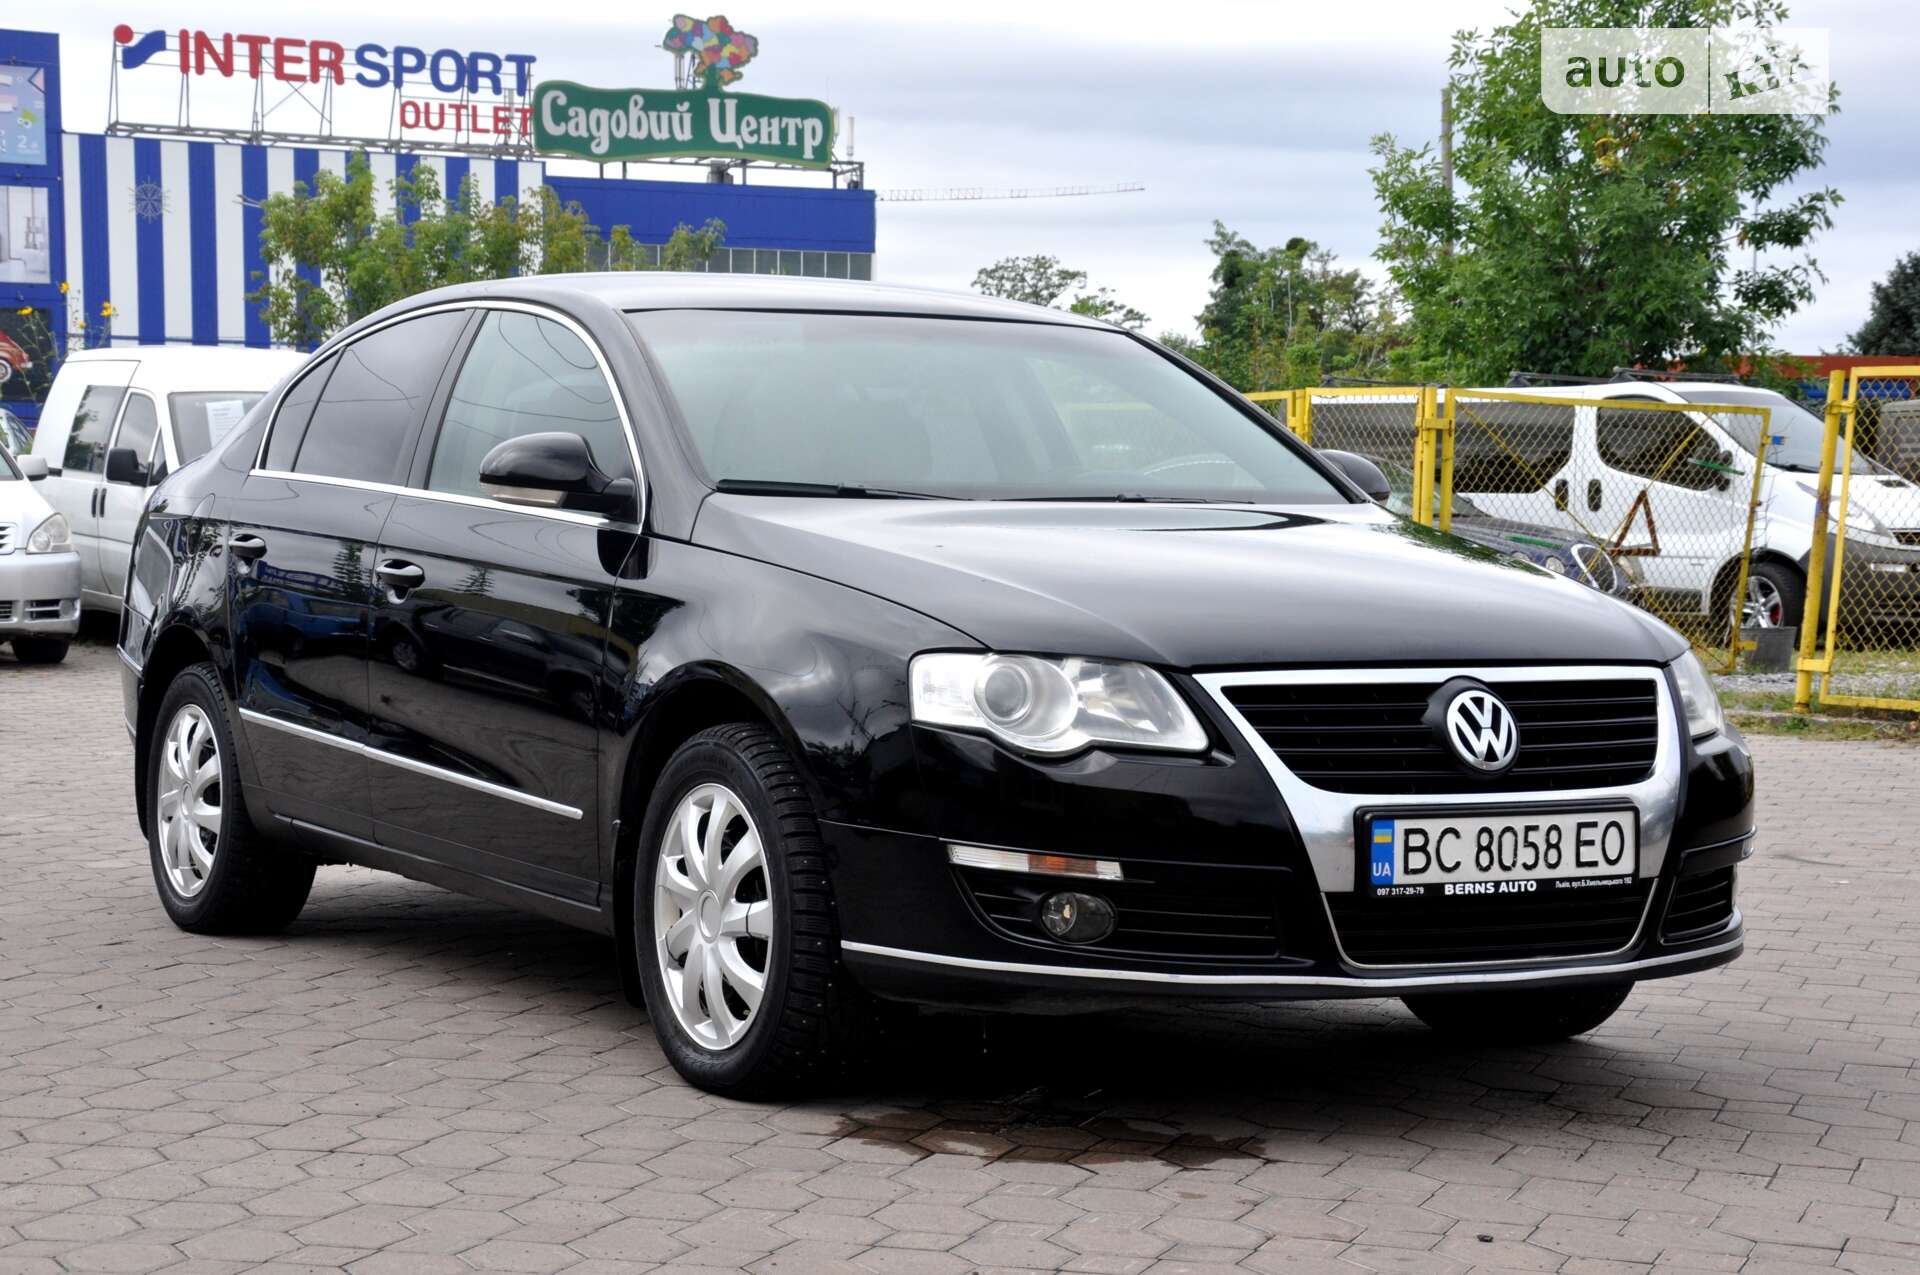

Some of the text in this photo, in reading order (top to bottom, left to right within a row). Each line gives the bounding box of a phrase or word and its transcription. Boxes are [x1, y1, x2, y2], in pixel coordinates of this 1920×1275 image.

[400, 100, 535, 137] OUTLET
[541, 90, 824, 159] Садовий Центр
[1403, 820, 1625, 875] BC 8058 EO
[1372, 862, 1392, 877] UA
[1376, 888, 1390, 896] 097
[1444, 880, 1537, 895] BERNS AUTO
